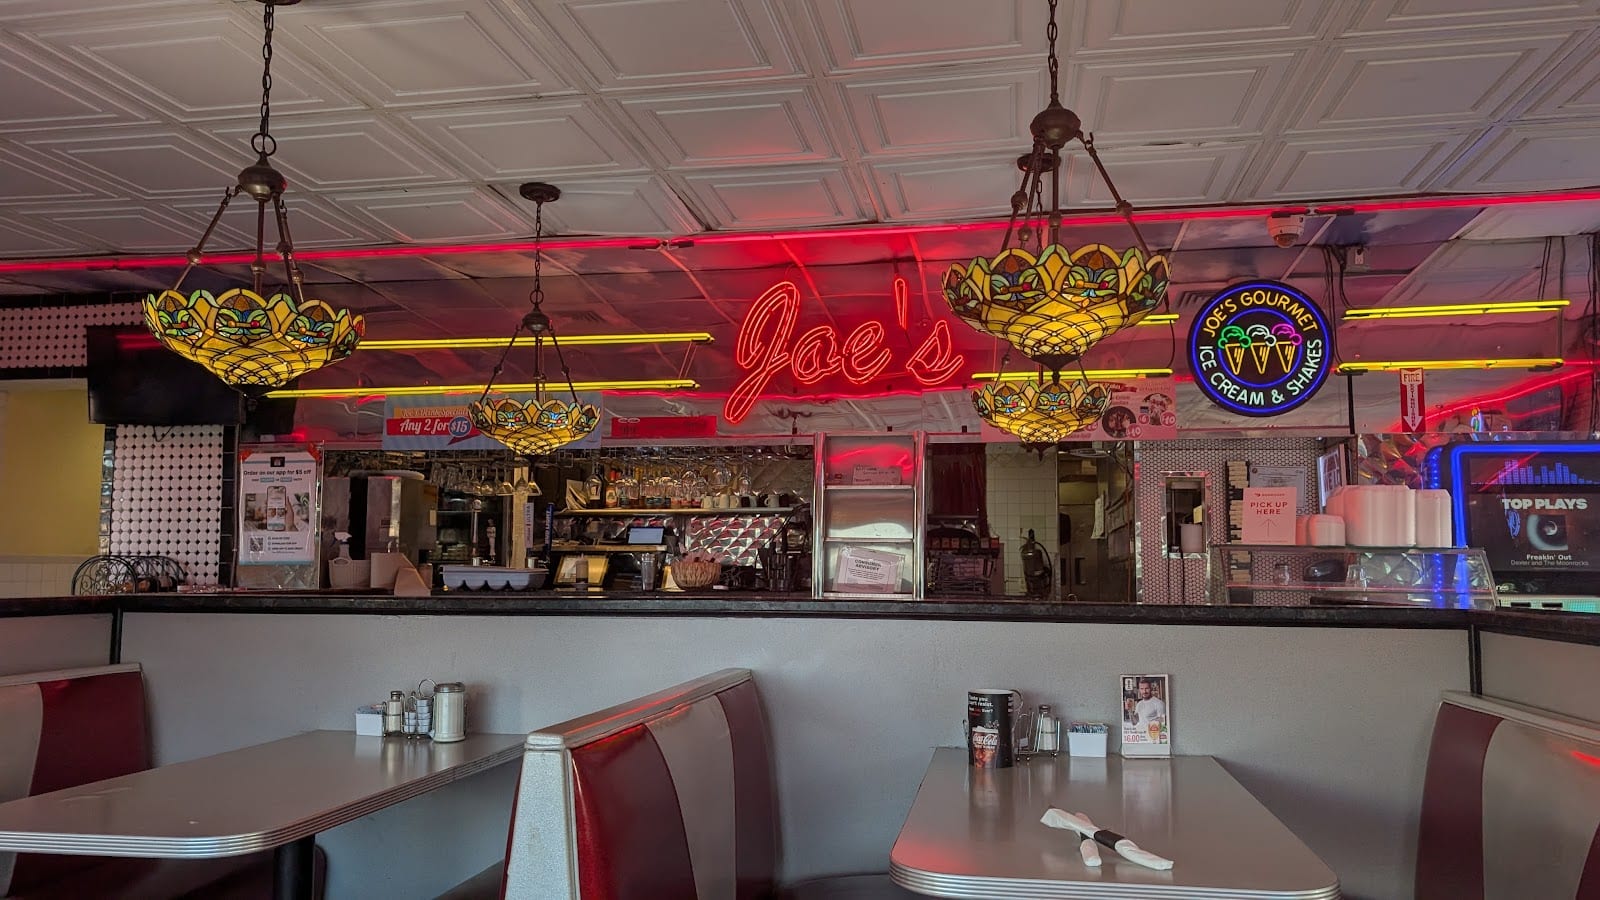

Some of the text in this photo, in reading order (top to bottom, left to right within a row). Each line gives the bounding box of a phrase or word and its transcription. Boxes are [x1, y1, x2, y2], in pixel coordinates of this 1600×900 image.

[1202, 290, 1319, 338] JOE'S GOURMET
[724, 278, 965, 424] Joe's
[1199, 339, 1323, 406] ICE CREAM & SHAKES
[1403, 373, 1420, 382] FIRE
[400, 418, 468, 435] Any 2 for $15
[1502, 498, 1588, 510] TOP PLAYS
